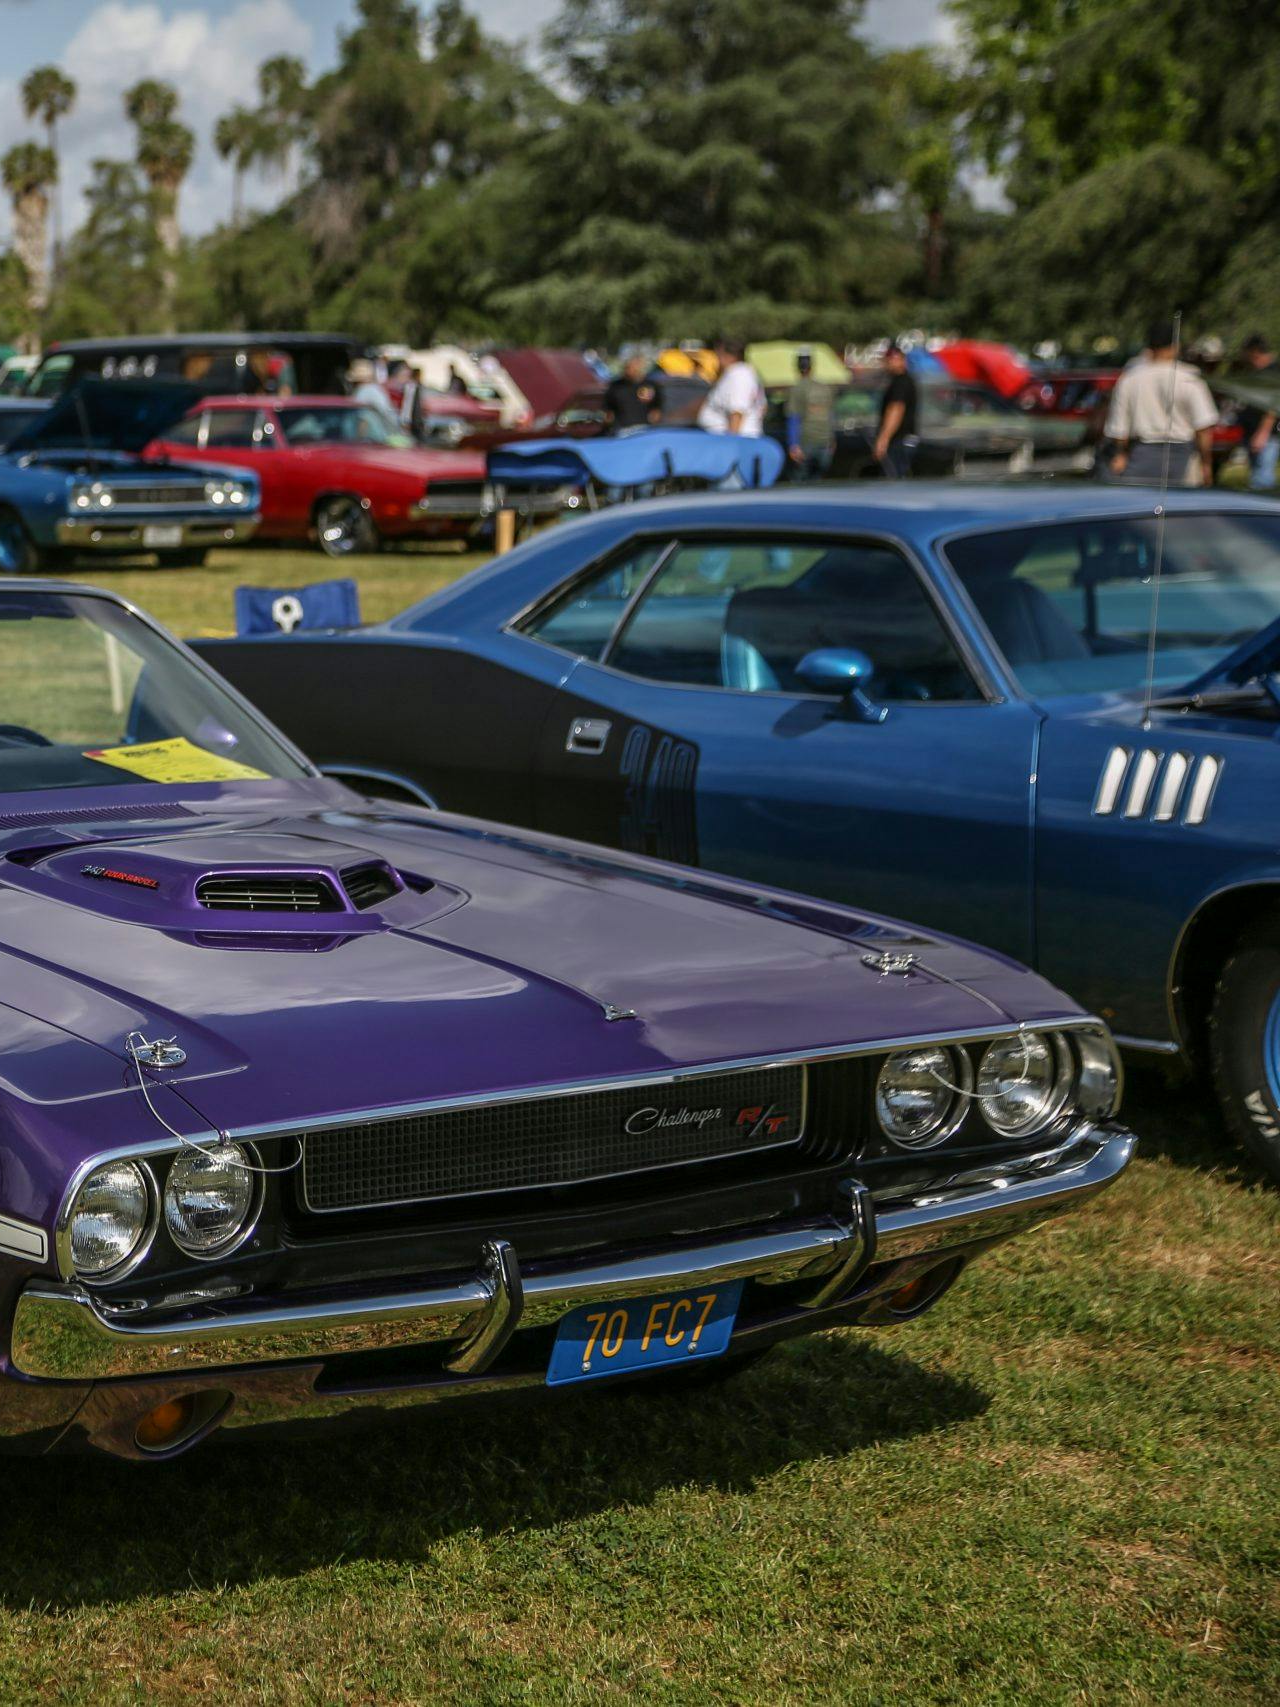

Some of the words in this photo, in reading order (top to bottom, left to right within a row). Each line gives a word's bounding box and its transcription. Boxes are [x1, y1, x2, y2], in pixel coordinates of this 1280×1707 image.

[625, 1106, 722, 1135] Challenger
[736, 1103, 790, 1137] R/T
[583, 1308, 629, 1362] 70
[640, 1293, 718, 1351] FC7
